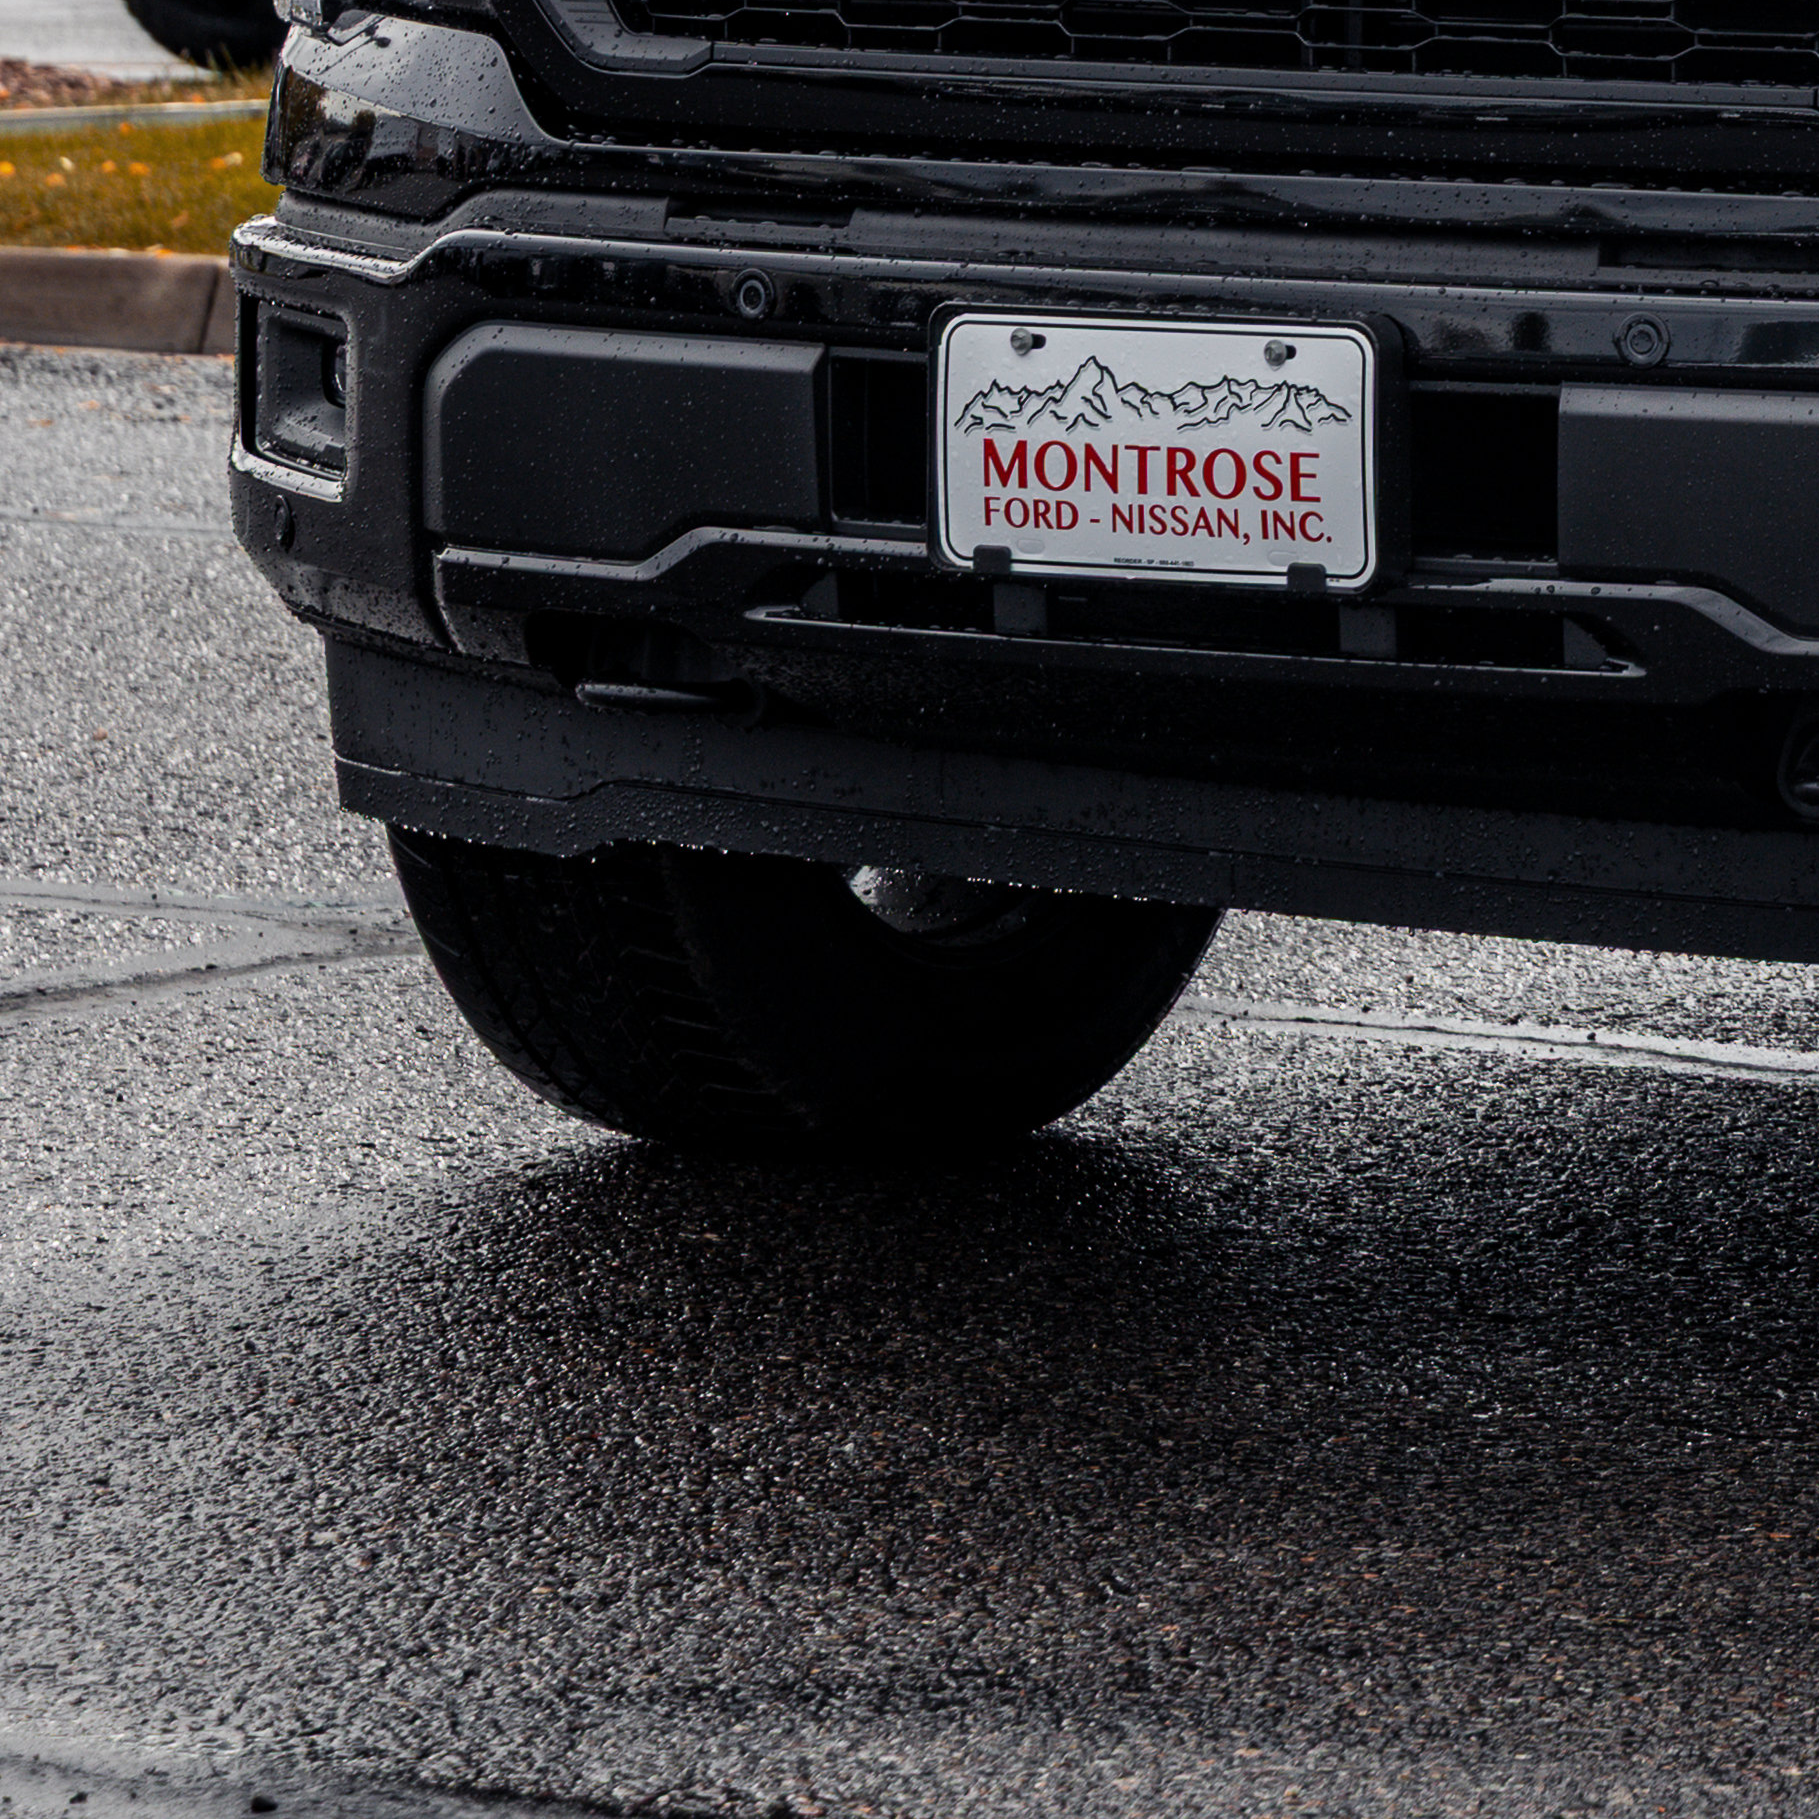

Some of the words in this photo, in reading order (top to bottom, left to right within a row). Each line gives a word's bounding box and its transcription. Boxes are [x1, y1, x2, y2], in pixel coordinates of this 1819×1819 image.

[982, 437, 1321, 503] MONTROSE
[983, 496, 1079, 530] FORD
[1111, 503, 1251, 545] NISSAN,
[1260, 509, 1332, 544] INC.
